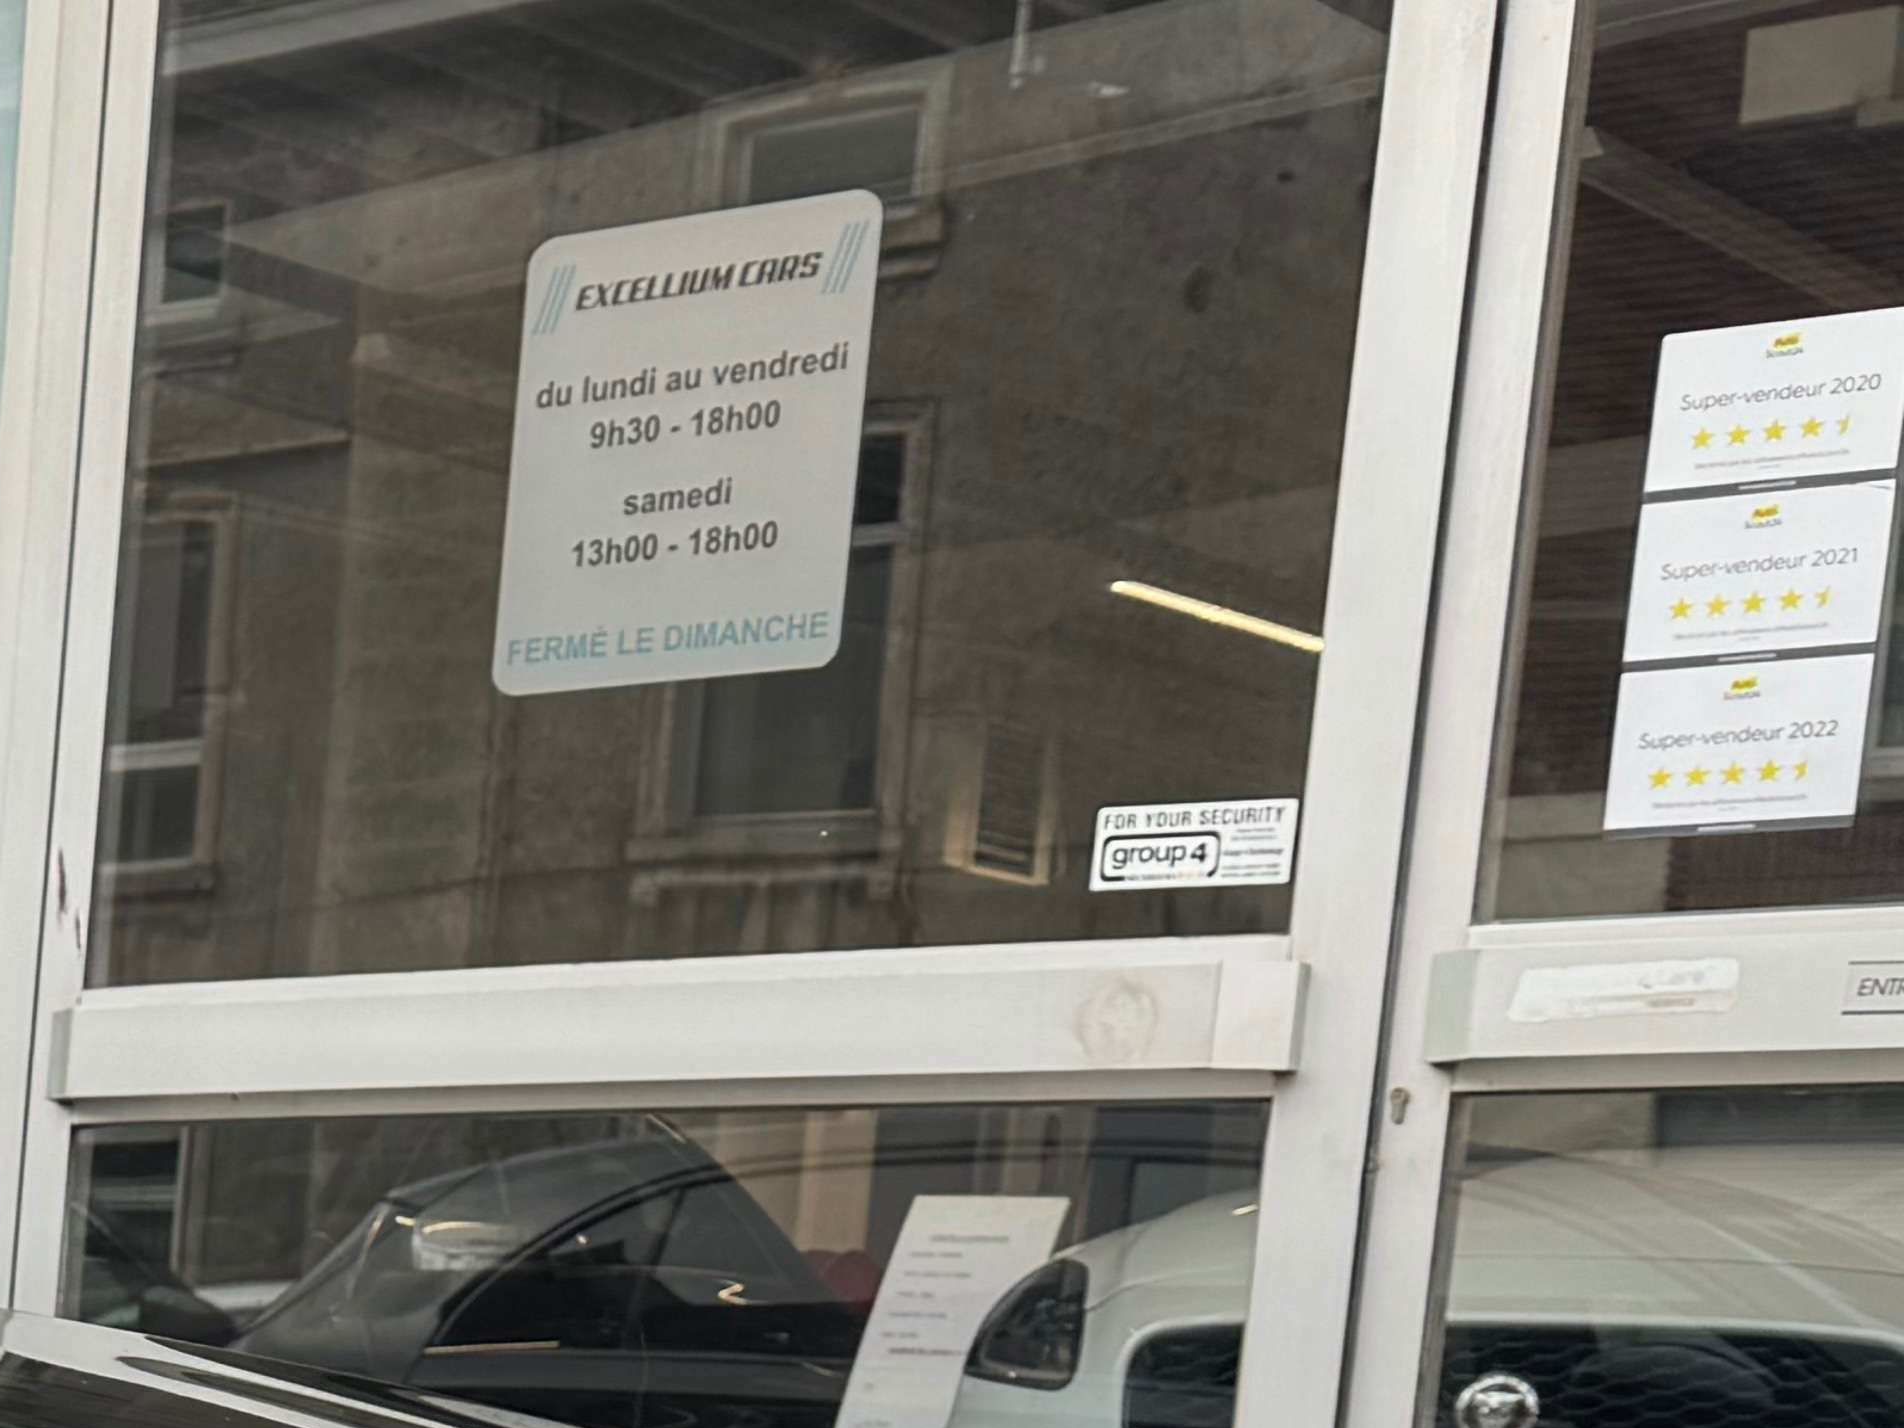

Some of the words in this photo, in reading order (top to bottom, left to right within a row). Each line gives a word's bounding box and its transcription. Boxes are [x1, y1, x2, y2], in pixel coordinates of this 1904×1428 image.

[574, 265, 733, 311] EXCELLIUM
[737, 251, 823, 289] CARS
[536, 381, 572, 409] du
[582, 368, 656, 403] lundi
[666, 369, 701, 394] au
[712, 343, 849, 385] vendredi
[1680, 381, 1826, 412] Super-vendeur
[1830, 373, 1882, 394] 2020
[589, 414, 660, 449] 9h30
[691, 400, 781, 437] 18h00
[623, 478, 732, 516] samedi
[572, 533, 657, 567] 13h00
[688, 521, 778, 556] 18h00
[1660, 552, 1806, 582] Super-vendeur
[1811, 547, 1859, 567] 2021
[507, 625, 608, 665] FERMÉ
[617, 626, 654, 655] LE
[664, 612, 829, 651] DIMANCHE
[1638, 724, 1784, 751] Super-vendeur
[1788, 720, 1839, 739] 2022
[1103, 813, 1137, 830] FOR
[1146, 811, 1192, 828] YOUR
[1199, 806, 1287, 826] SECURITY
[1112, 844, 1186, 869] group
[1191, 843, 1208, 863] 4
